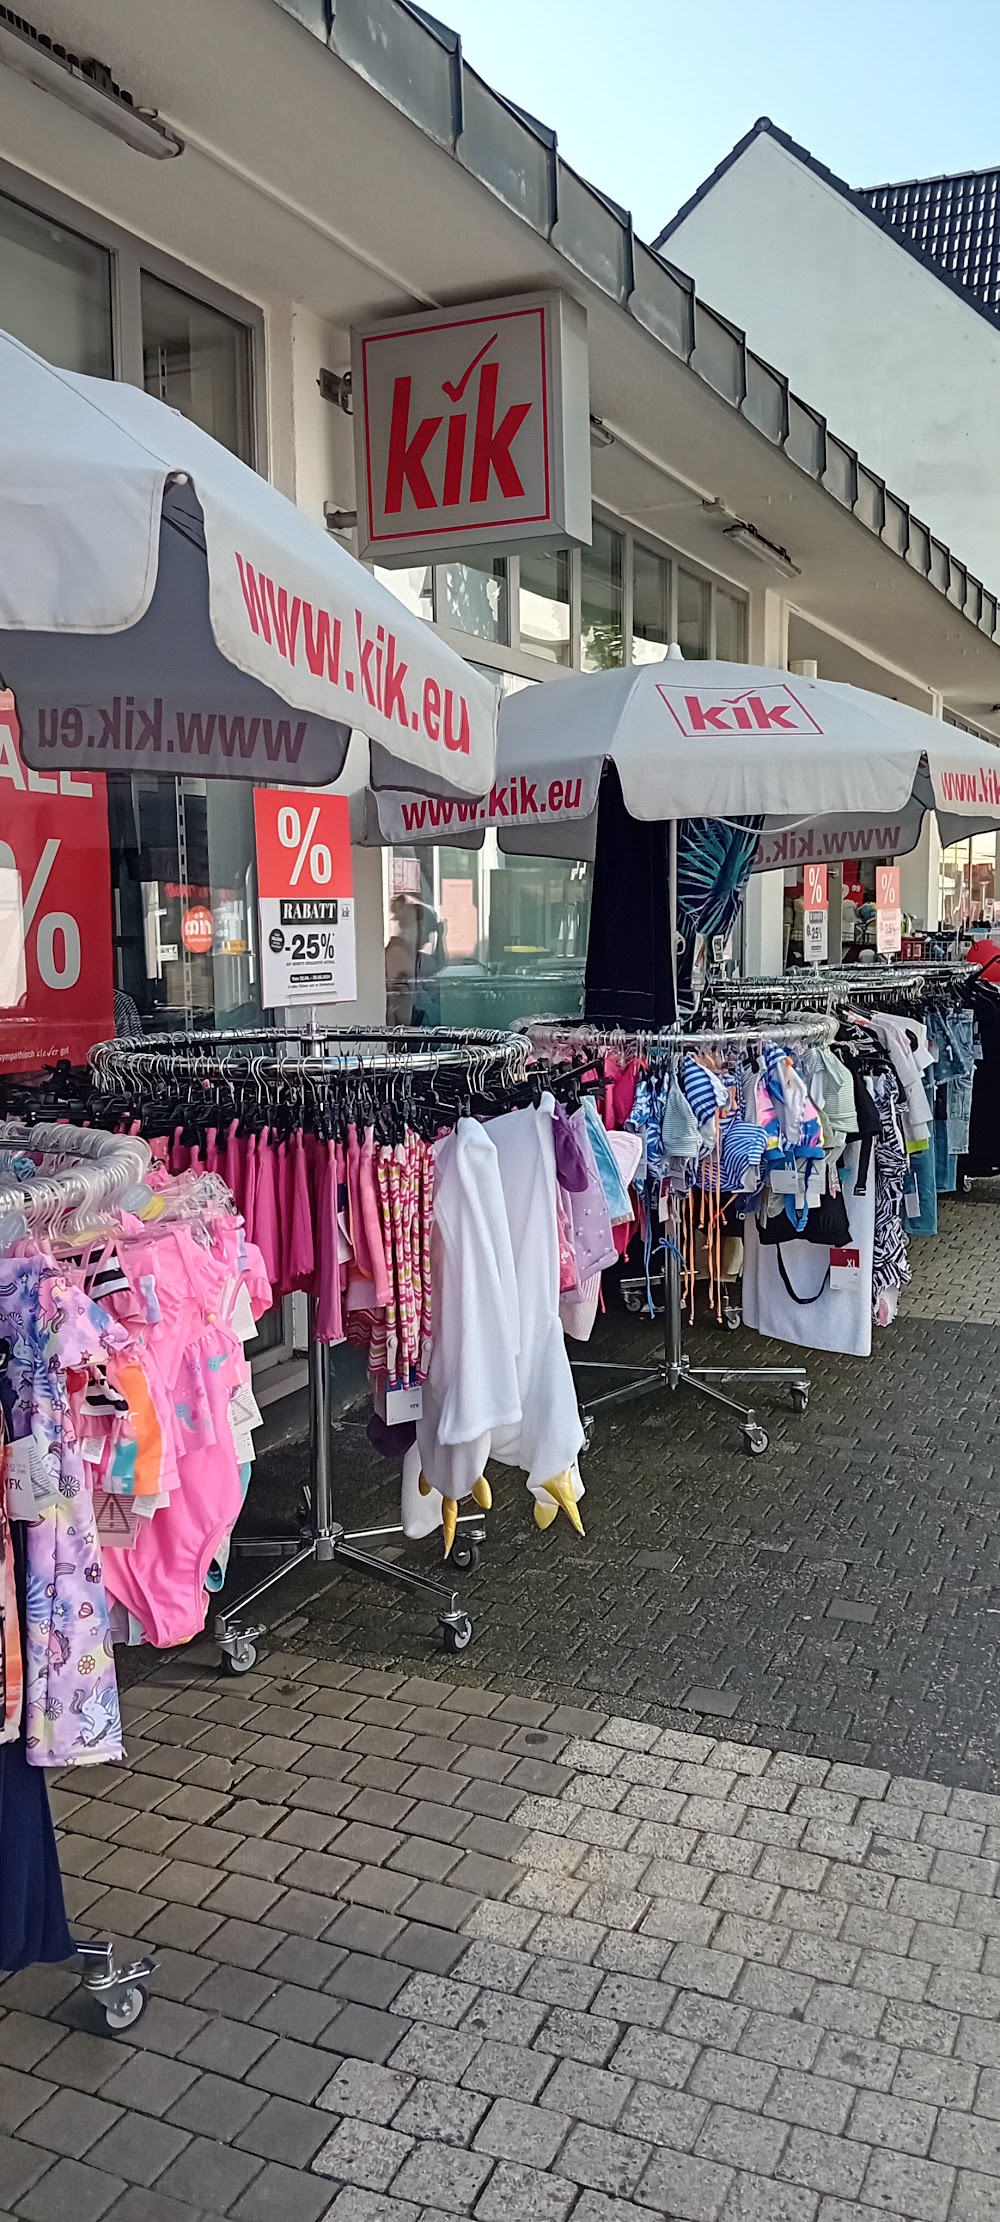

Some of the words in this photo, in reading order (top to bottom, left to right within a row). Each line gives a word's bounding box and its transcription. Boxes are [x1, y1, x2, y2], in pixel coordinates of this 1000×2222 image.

[384, 333, 532, 514] kik
[235, 552, 470, 755] www.kik.eu
[685, 690, 799, 730] kik
[402, 776, 582, 830] www.kik.eu
[277, 806, 332, 885] %
[283, 902, 336, 919] RABATT
[60, 1046, 70, 1056] gut
